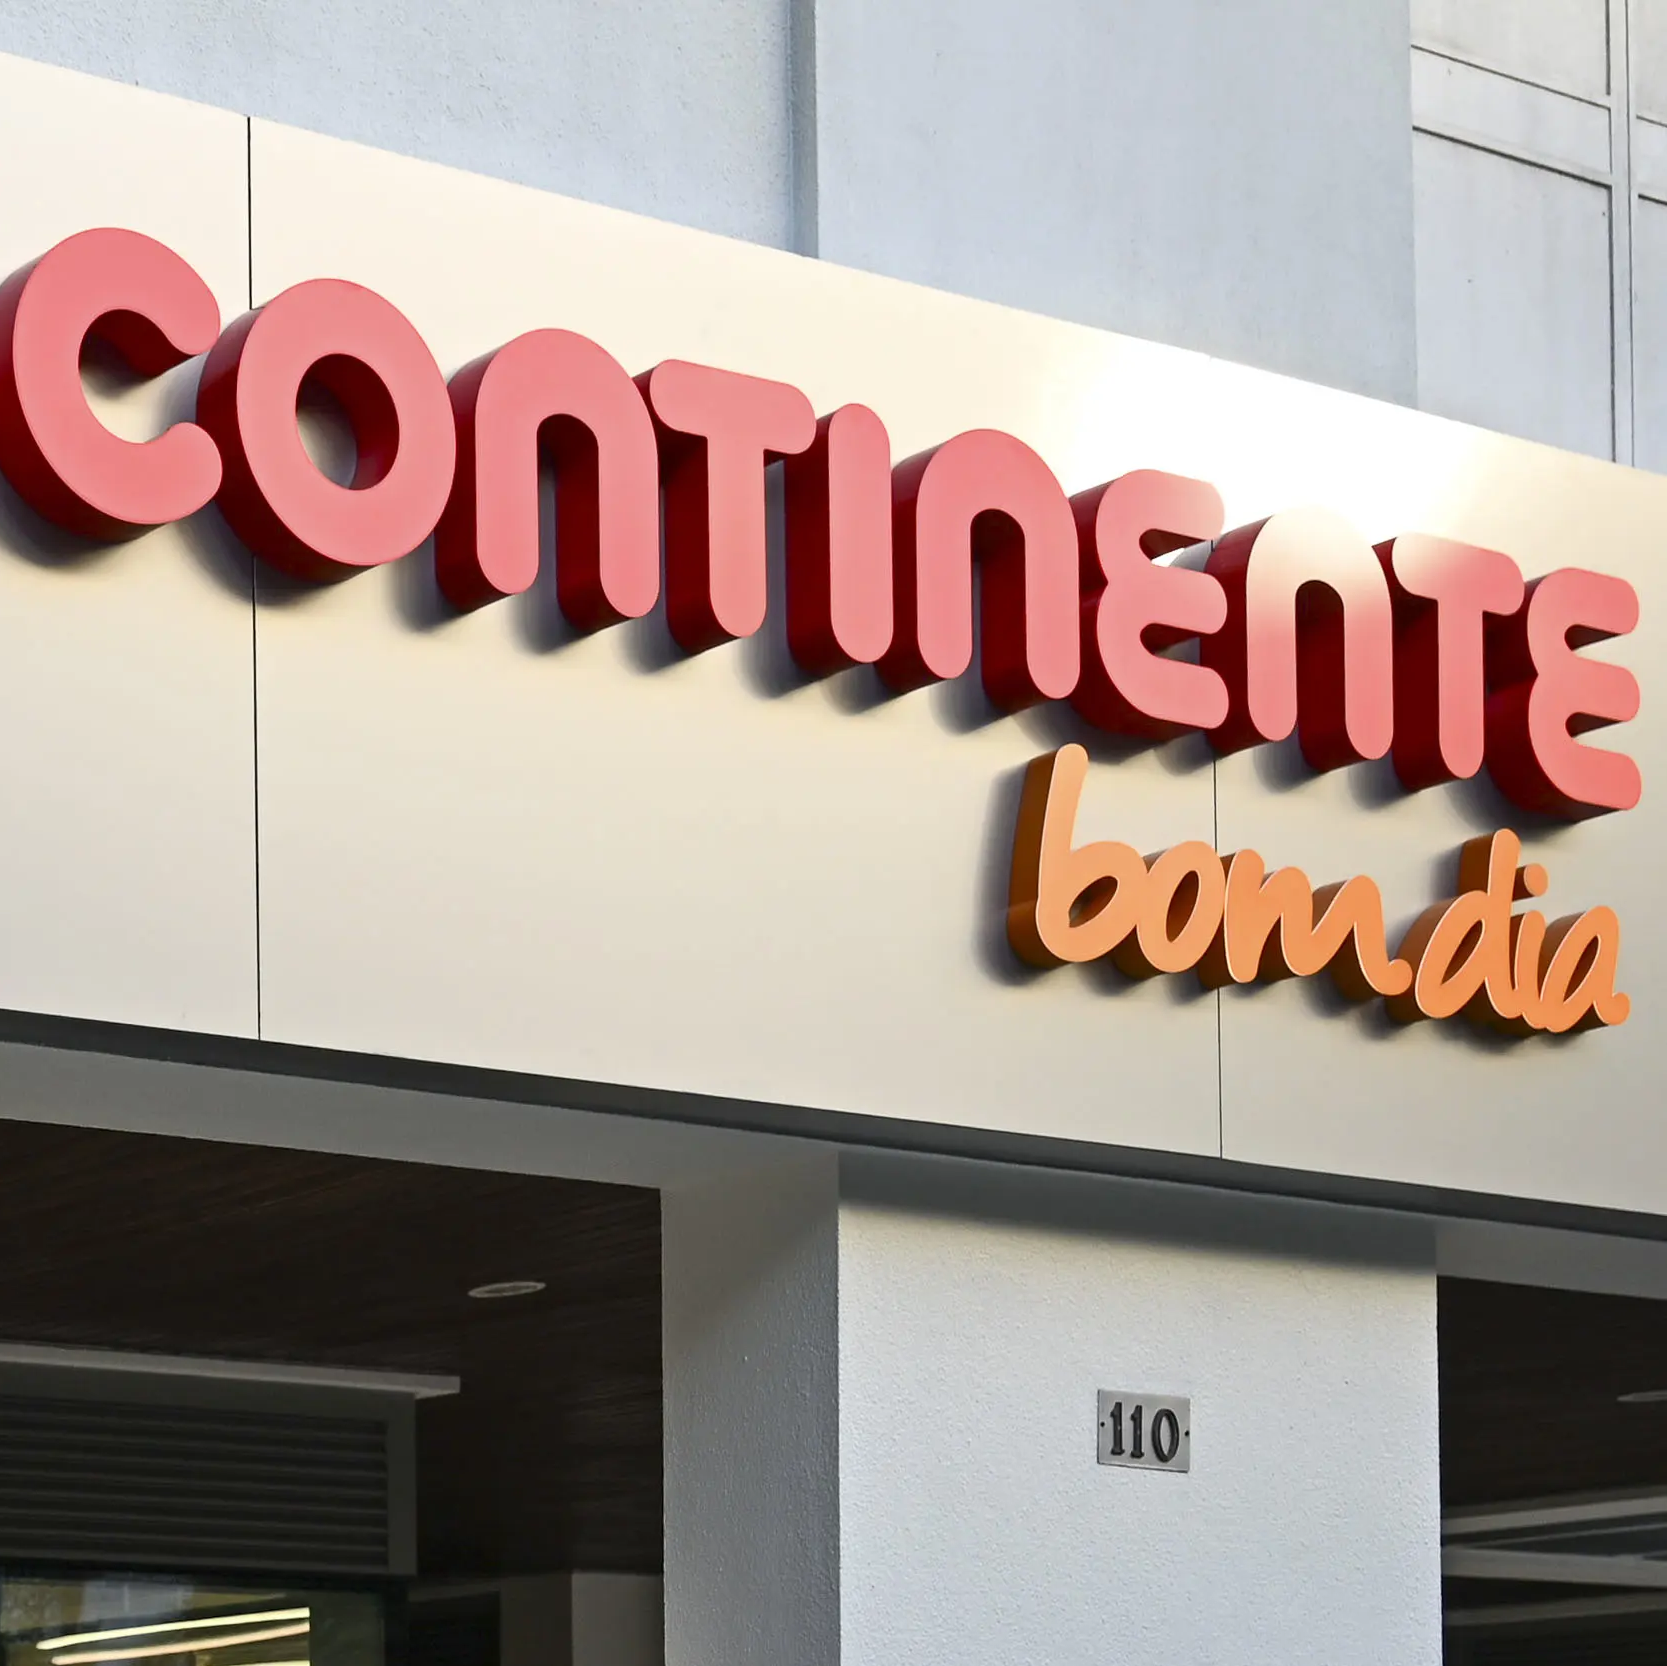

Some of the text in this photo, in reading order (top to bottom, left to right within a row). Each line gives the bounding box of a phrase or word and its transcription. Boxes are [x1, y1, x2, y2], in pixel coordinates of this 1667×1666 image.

[1007, 743, 1631, 1034] bom dia
[1110, 1401, 1181, 1463] 110
